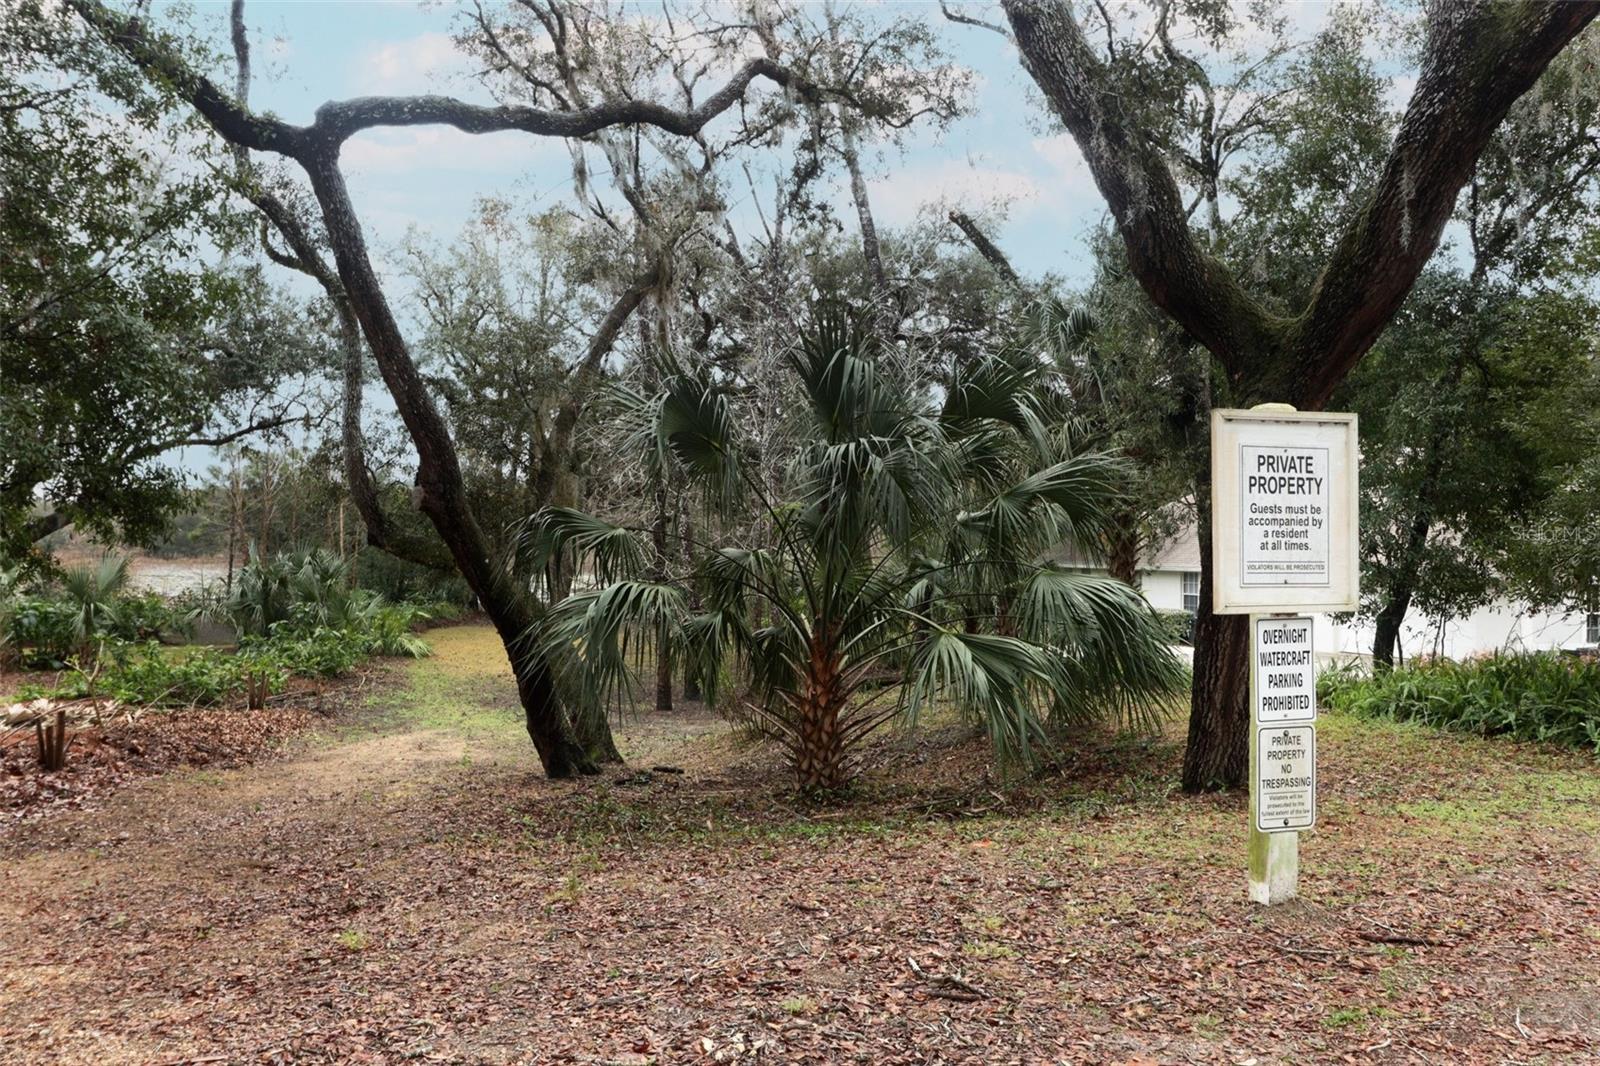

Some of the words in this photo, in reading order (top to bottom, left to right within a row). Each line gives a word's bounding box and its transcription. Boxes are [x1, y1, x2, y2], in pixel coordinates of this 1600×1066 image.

[1258, 455, 1313, 473] PRIVATE
[1249, 476, 1322, 495] PROPERTY
[1250, 503, 1282, 514] Guests
[1285, 504, 1308, 514] must
[1310, 504, 1321, 514] be
[1248, 516, 1309, 528] accompanied
[1312, 516, 1323, 529] by
[1264, 530, 1269, 538] a
[1271, 529, 1308, 539] resident
[1260, 541, 1269, 551] at
[1271, 540, 1281, 551] all
[1284, 540, 1312, 551] times.
[1263, 628, 1307, 645] OVERNIGHT
[1260, 650, 1310, 667] WATERCRAFT
[1268, 673, 1303, 689] PARKING
[1263, 694, 1310, 711] PROHIBITED
[1272, 736, 1301, 746] PRIVATE
[1267, 749, 1306, 760] PROPERTY
[1281, 764, 1292, 774] NO
[1262, 777, 1311, 788] TRESPASSING
